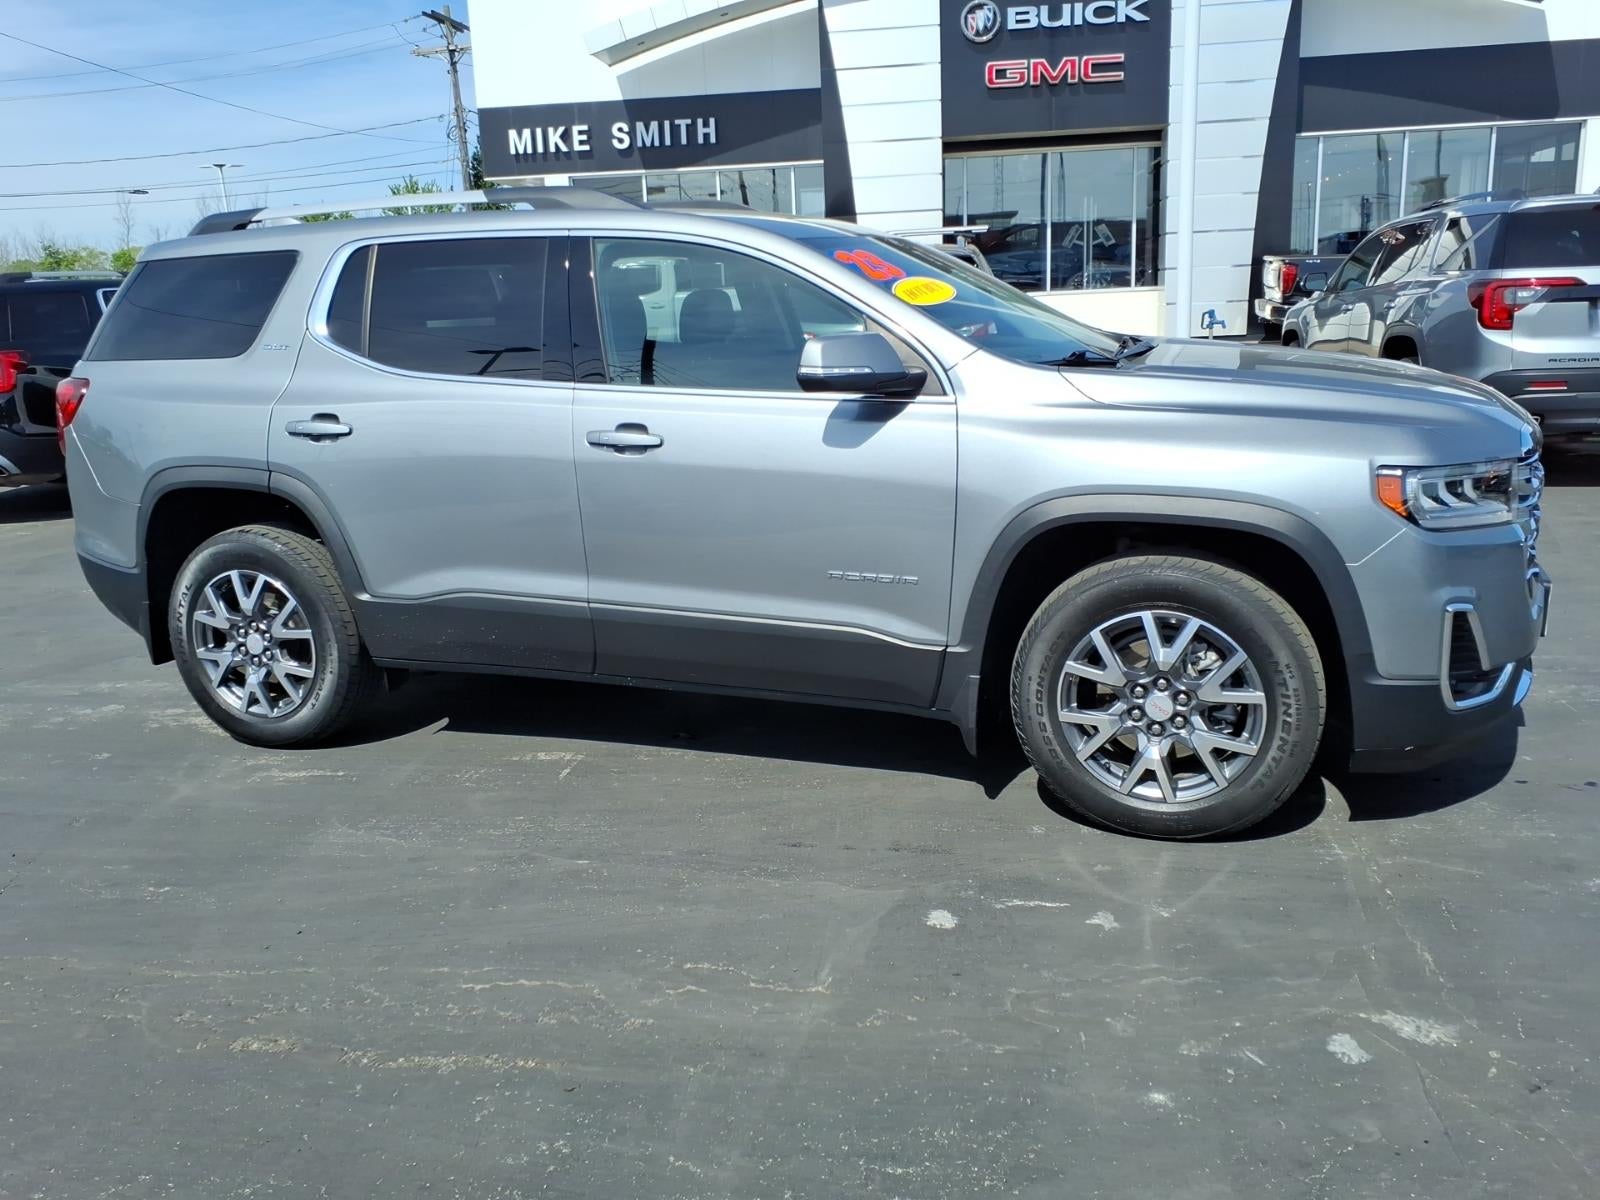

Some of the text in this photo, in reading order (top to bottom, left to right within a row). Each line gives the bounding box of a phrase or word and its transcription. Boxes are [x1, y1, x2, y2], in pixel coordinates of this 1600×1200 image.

[1007, 0, 1151, 30] BUICK
[985, 53, 1125, 88] GMC
[508, 117, 717, 155] MIKE SMITH
[826, 570, 919, 585] ACADIA
